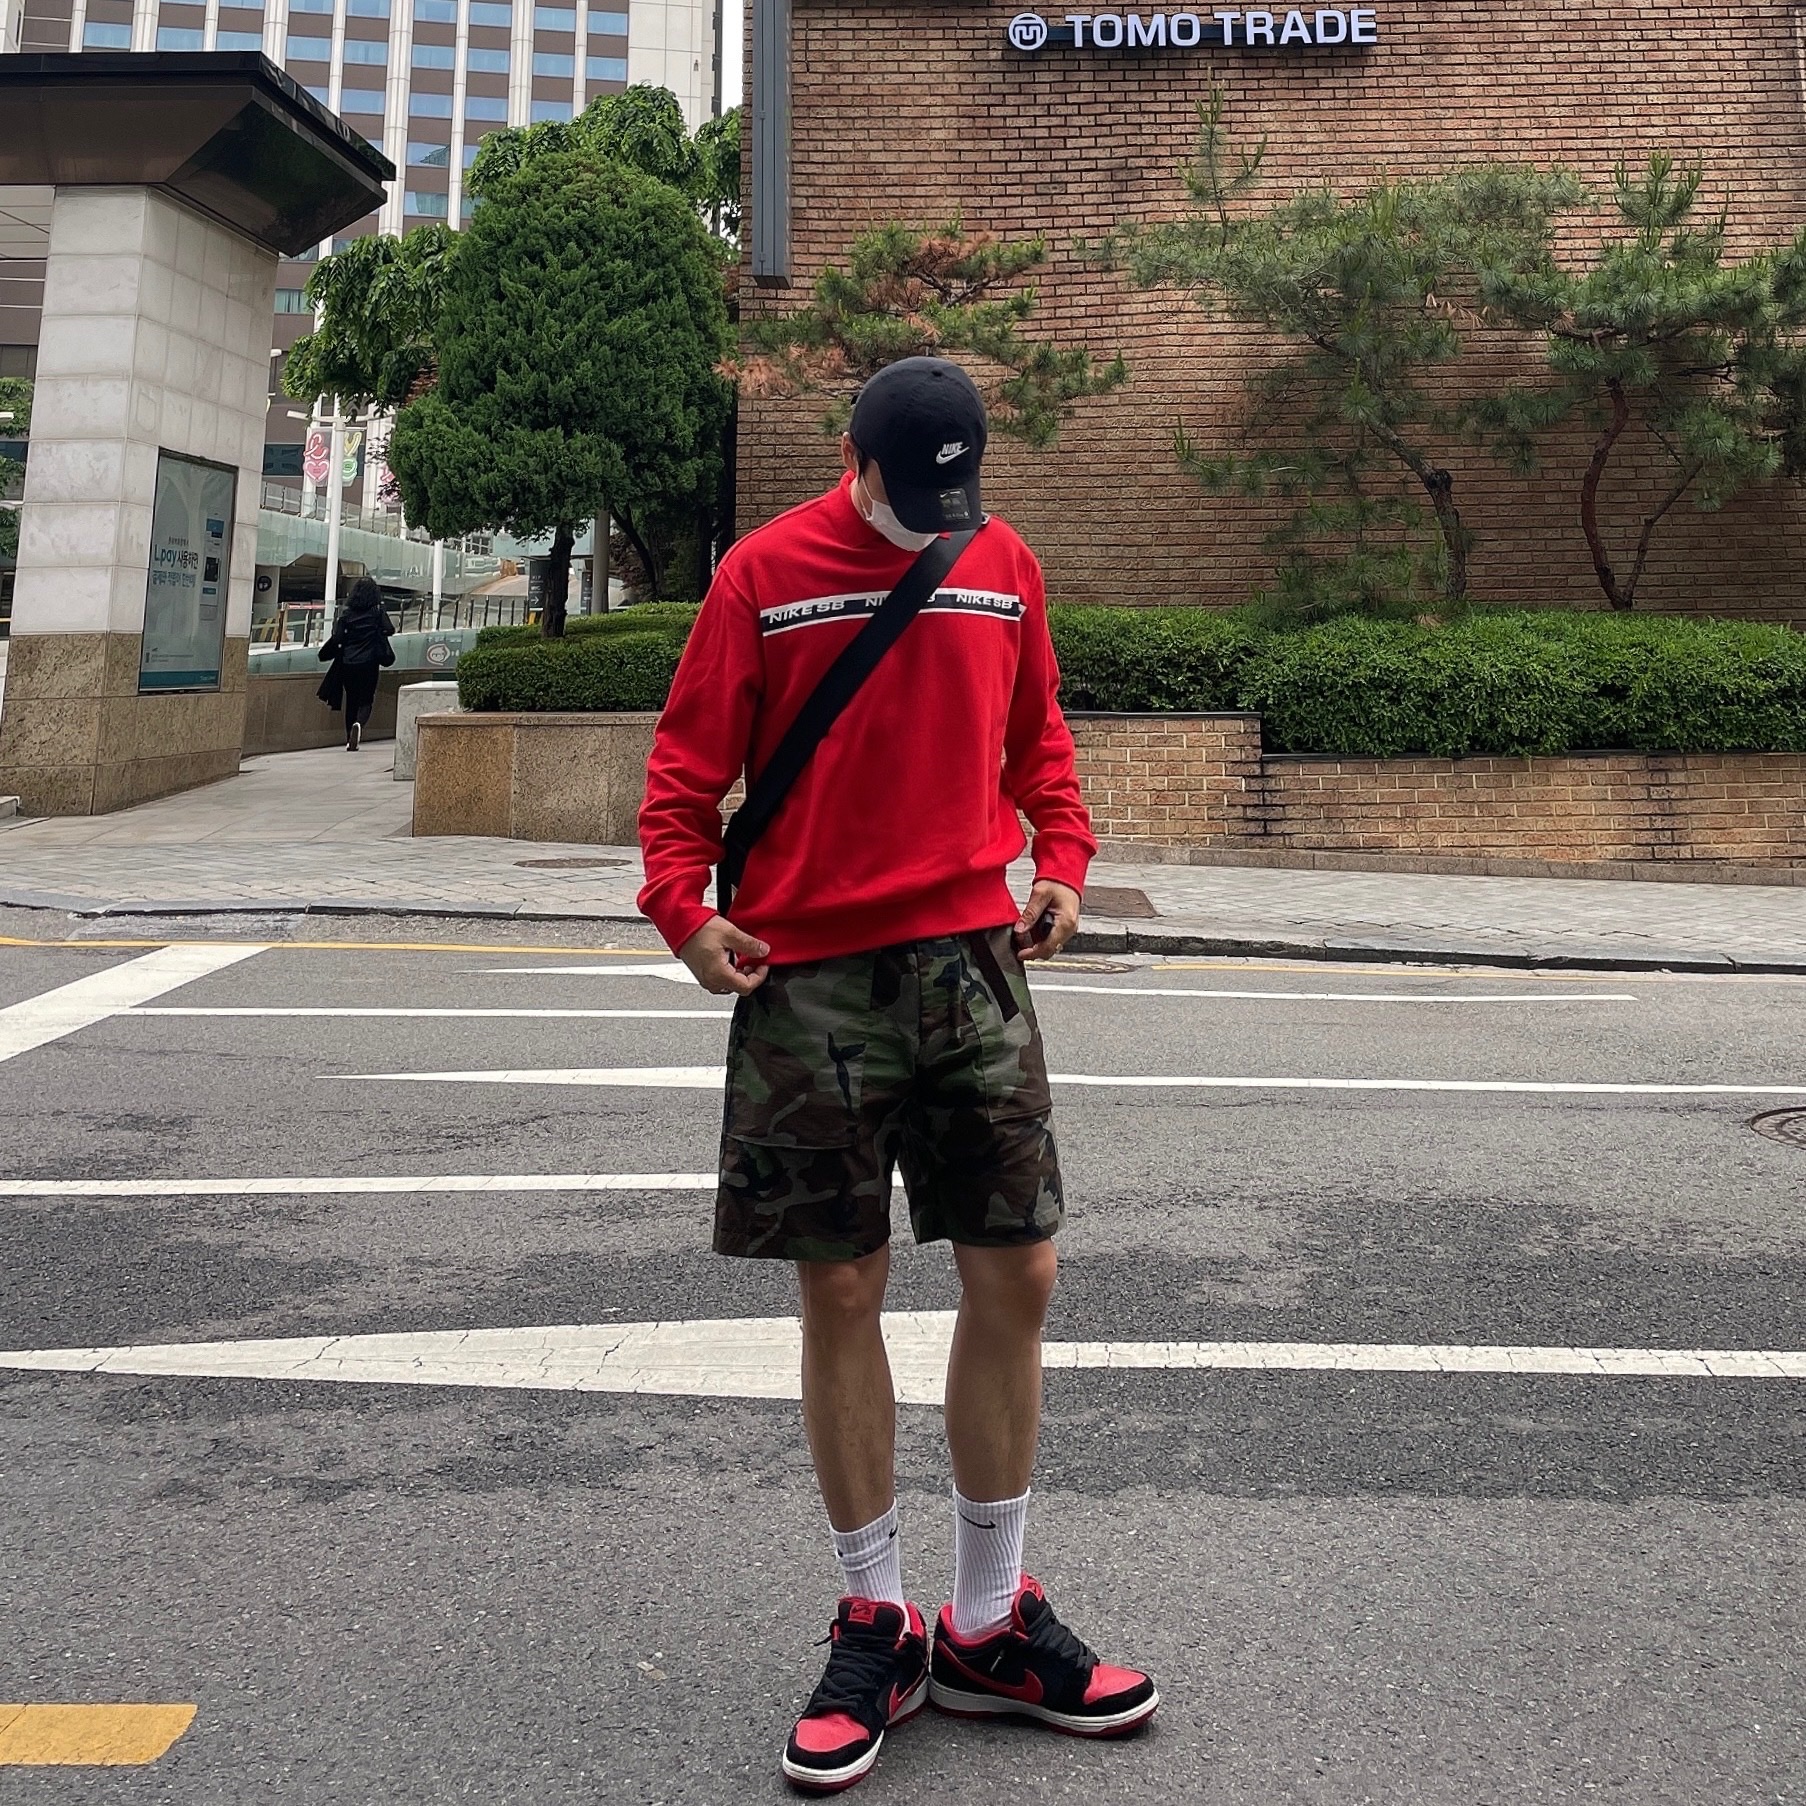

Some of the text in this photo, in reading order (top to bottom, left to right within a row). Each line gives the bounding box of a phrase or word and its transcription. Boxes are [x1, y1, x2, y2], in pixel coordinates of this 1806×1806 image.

[1065, 13, 1201, 48] TOMO
[1214, 9, 1378, 46] TRADE
[941, 441, 963, 455] NIKE
[769, 605, 813, 623] NIKE
[816, 600, 845, 613] SB
[956, 594, 991, 606] NIKE
[992, 599, 1013, 609] SB
